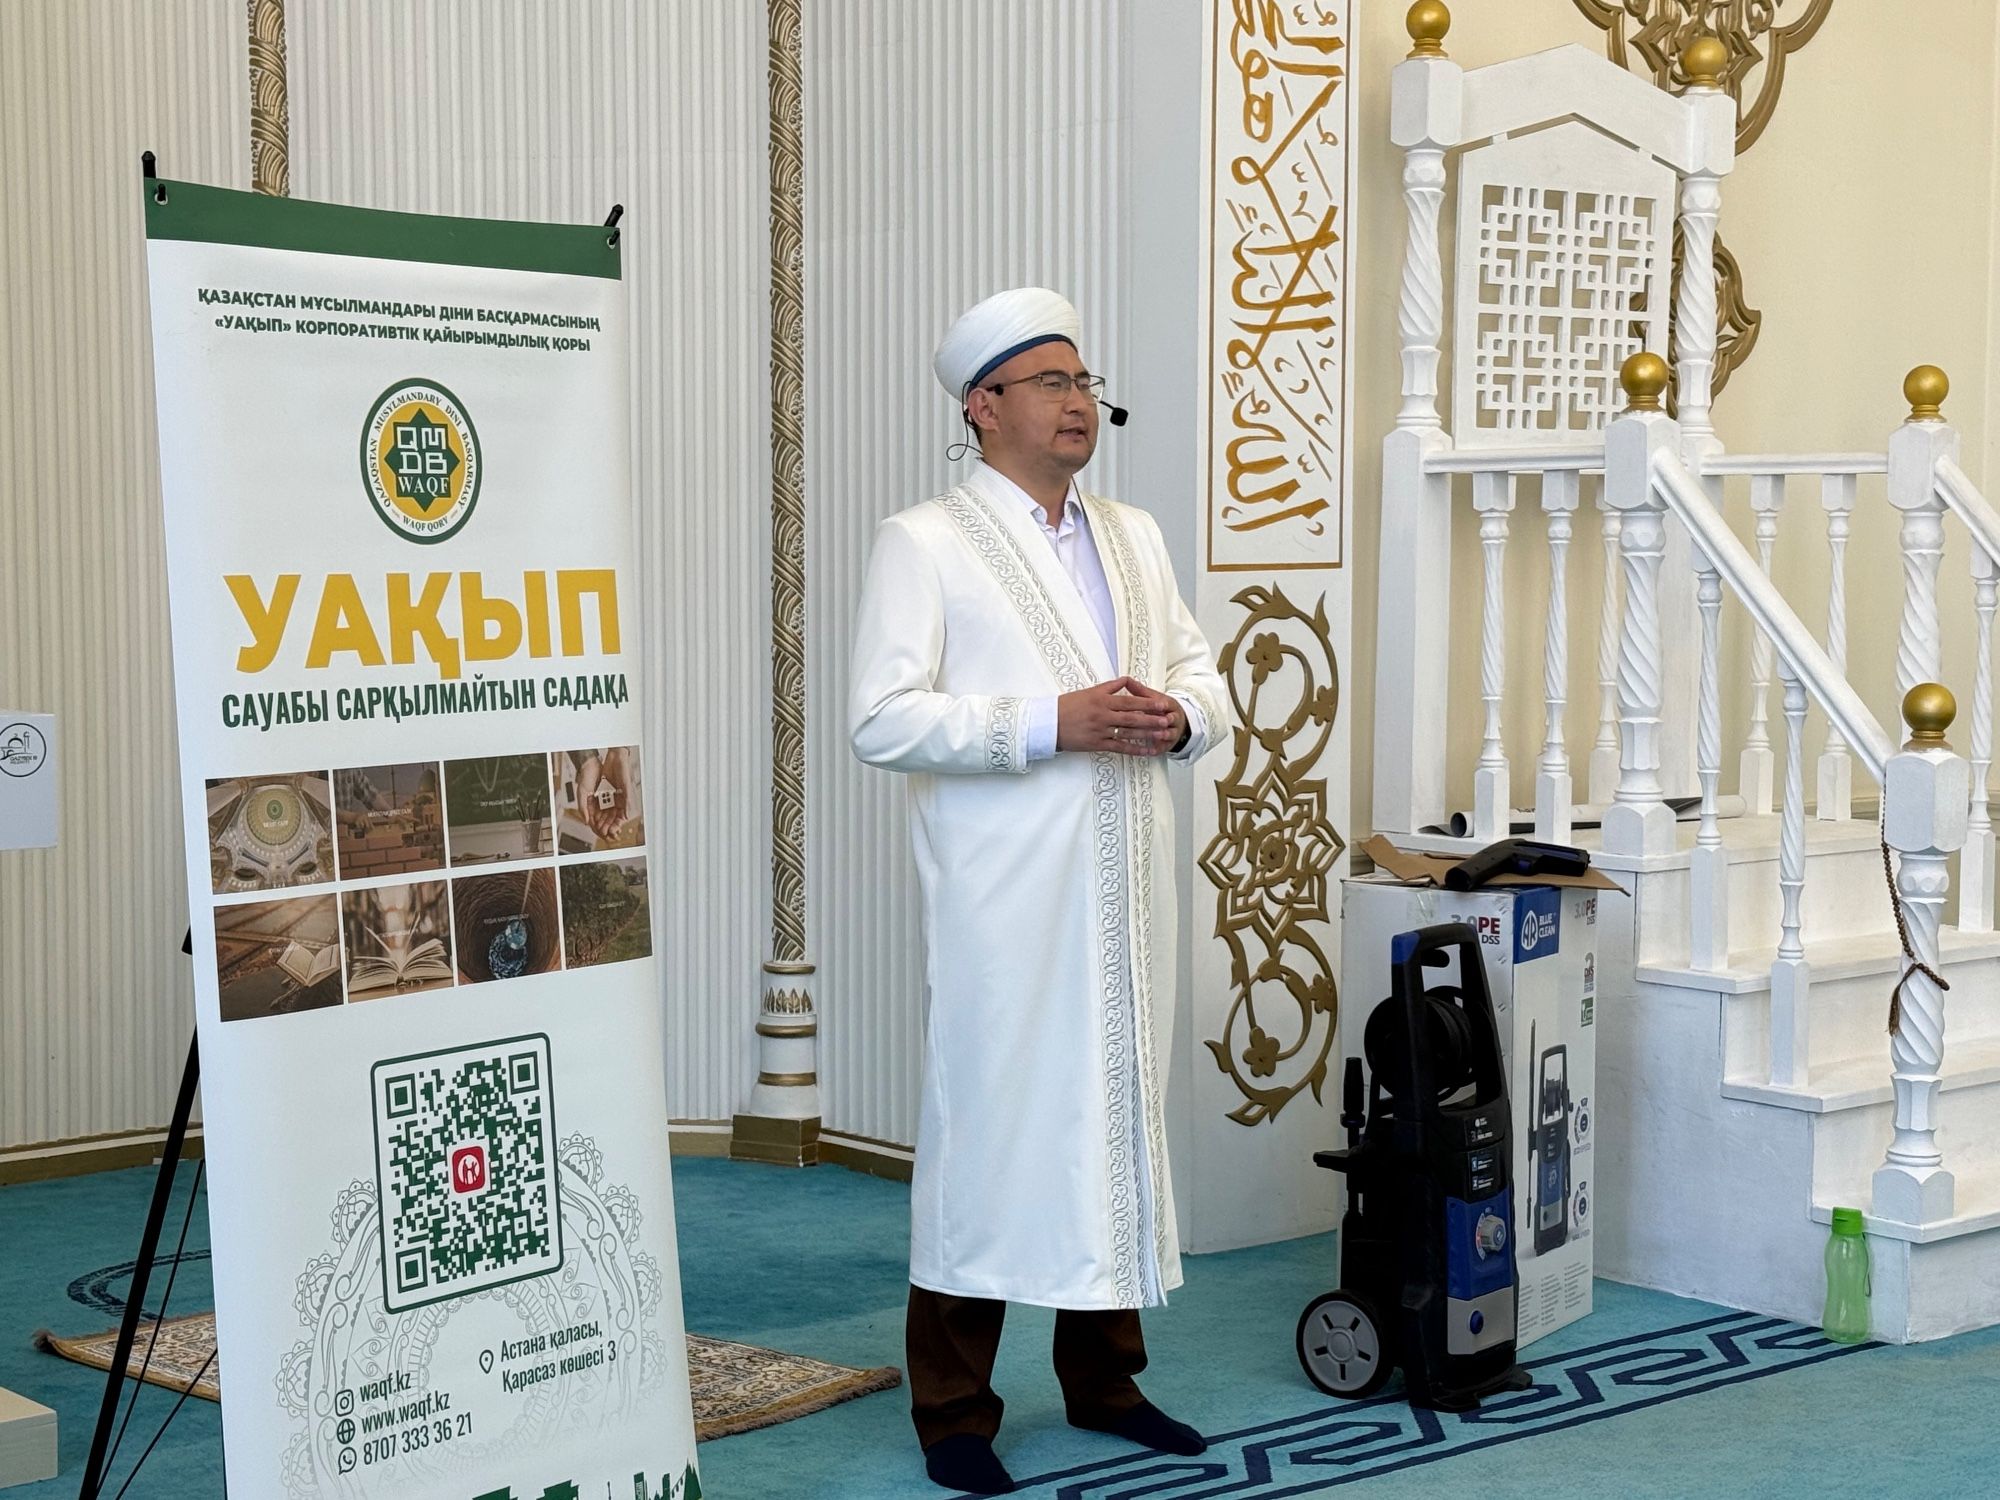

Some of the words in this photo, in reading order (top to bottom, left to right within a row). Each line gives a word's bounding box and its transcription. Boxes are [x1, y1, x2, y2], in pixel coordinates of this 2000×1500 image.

[198, 288, 296, 309] ҚАЗАҚСТАН
[300, 296, 436, 318] МҰСЫЛМАНДАРЫ
[439, 306, 474, 322] ДІНИ
[477, 309, 601, 332] БАСҚАРМАСЫНЫҢ
[215, 315, 291, 333] «УАҚЫП»
[296, 320, 420, 341] КОРПОРАТИВТІК
[423, 326, 550, 351] ҚАЙЫРЫМДЫЛЫҚ
[552, 338, 591, 352] ҚОРЫ
[375, 392, 442, 432] MUSYLMANDARY
[445, 405, 462, 427] DINI
[369, 438, 392, 508] QAZAQSTAN
[398, 476, 449, 497] WAQF
[458, 433, 474, 510] BASQARMASY
[403, 515, 427, 532] WAQF
[428, 516, 449, 532] QORY
[223, 569, 621, 680] УАҚЫП
[222, 690, 329, 732] САУАБЫ
[337, 674, 536, 723] САРҚЫЛМАЙТЫН
[543, 674, 629, 711] САДАҚА
[1481, 934, 1501, 945] DSS
[1538, 926, 1556, 938] CLEAN
[500, 1334, 546, 1363] Астана
[550, 1321, 603, 1350] қаласы,
[359, 1371, 412, 1403] waqf.kz
[502, 1362, 556, 1394] Қарасаз
[560, 1348, 604, 1376] көшесі
[607, 1340, 617, 1362] 3
[362, 1391, 451, 1434] www.waqf.kz
[363, 1435, 397, 1466] 8707
[402, 1427, 430, 1454] 333
[433, 1420, 453, 1445] 36
[456, 1411, 473, 1437] 21
